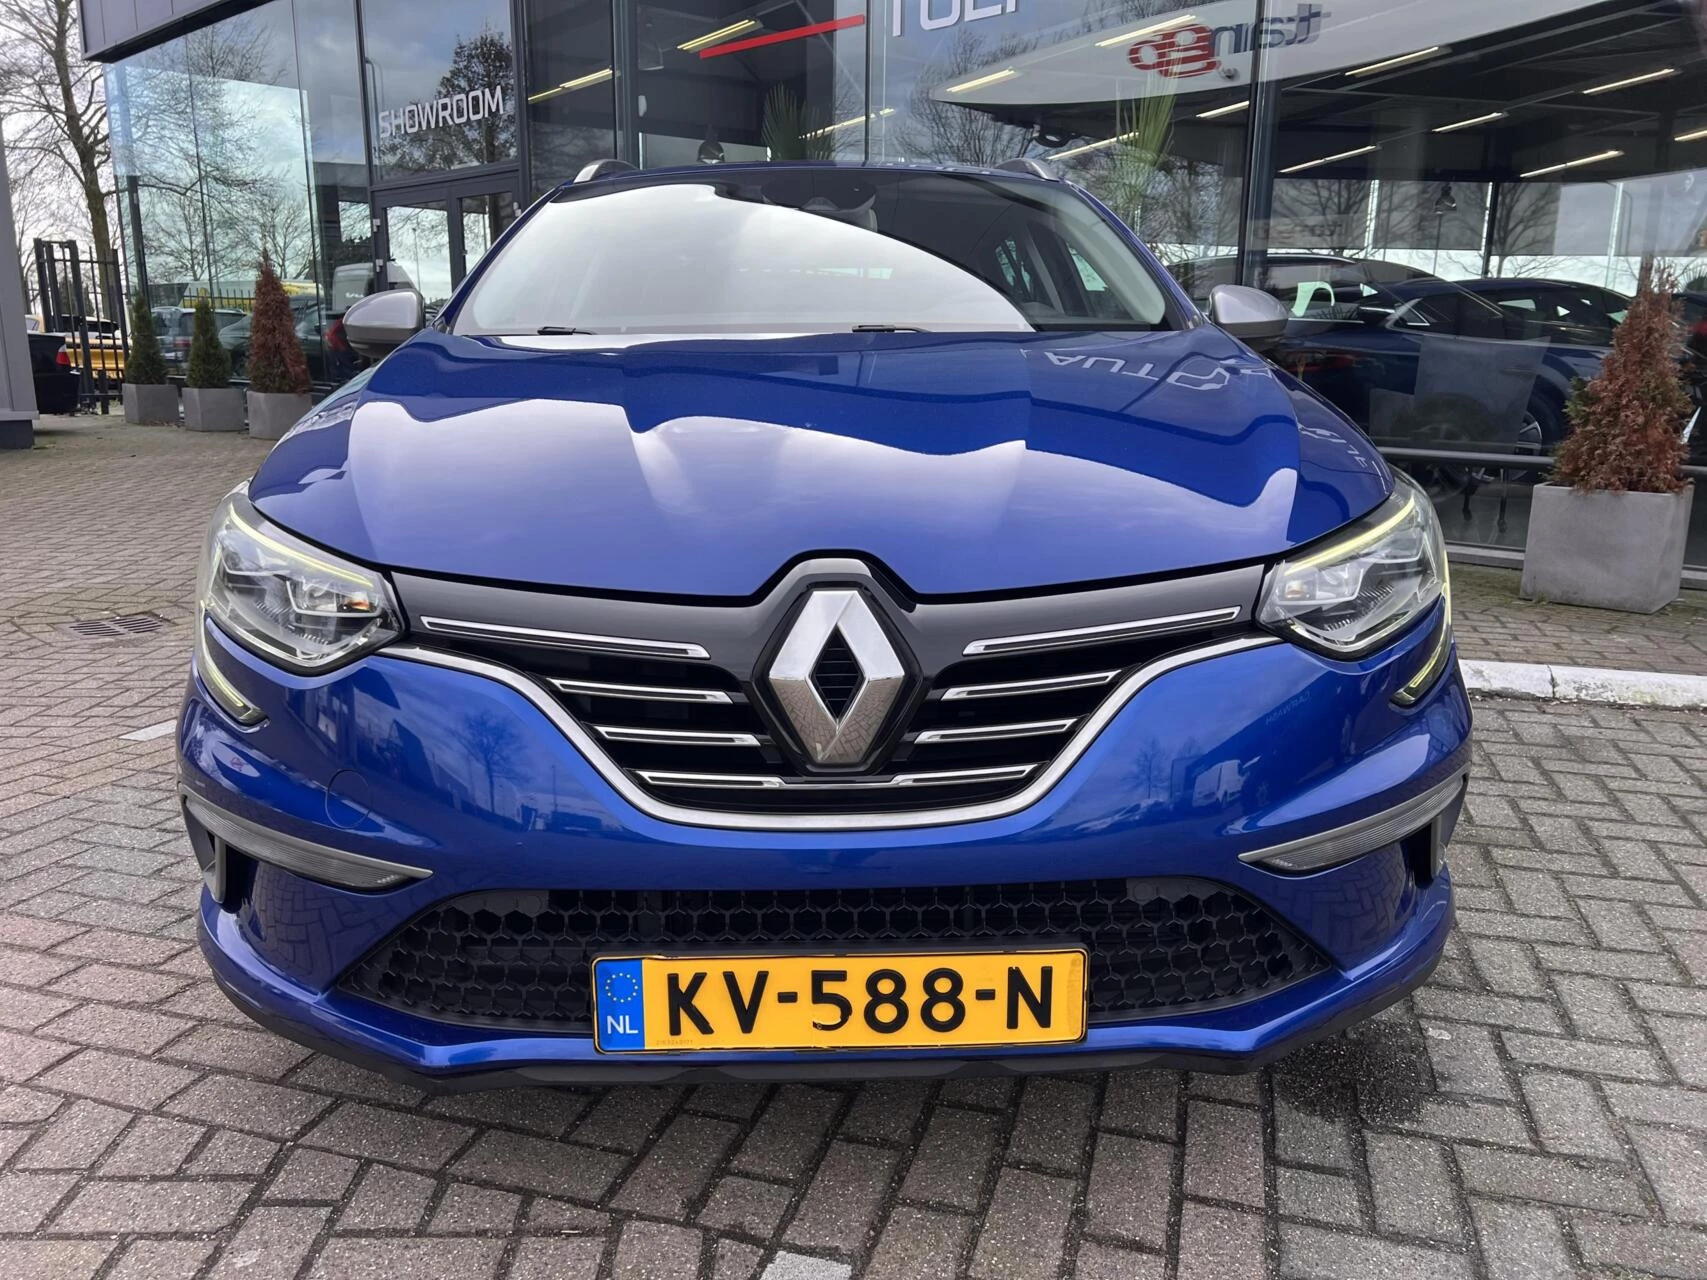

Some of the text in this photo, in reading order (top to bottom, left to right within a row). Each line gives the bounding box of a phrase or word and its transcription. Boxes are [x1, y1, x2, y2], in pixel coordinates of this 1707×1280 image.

[378, 85, 504, 138] SHOWROOM
[606, 1014, 639, 1035] NL
[666, 966, 1054, 1037] KV-588-N
